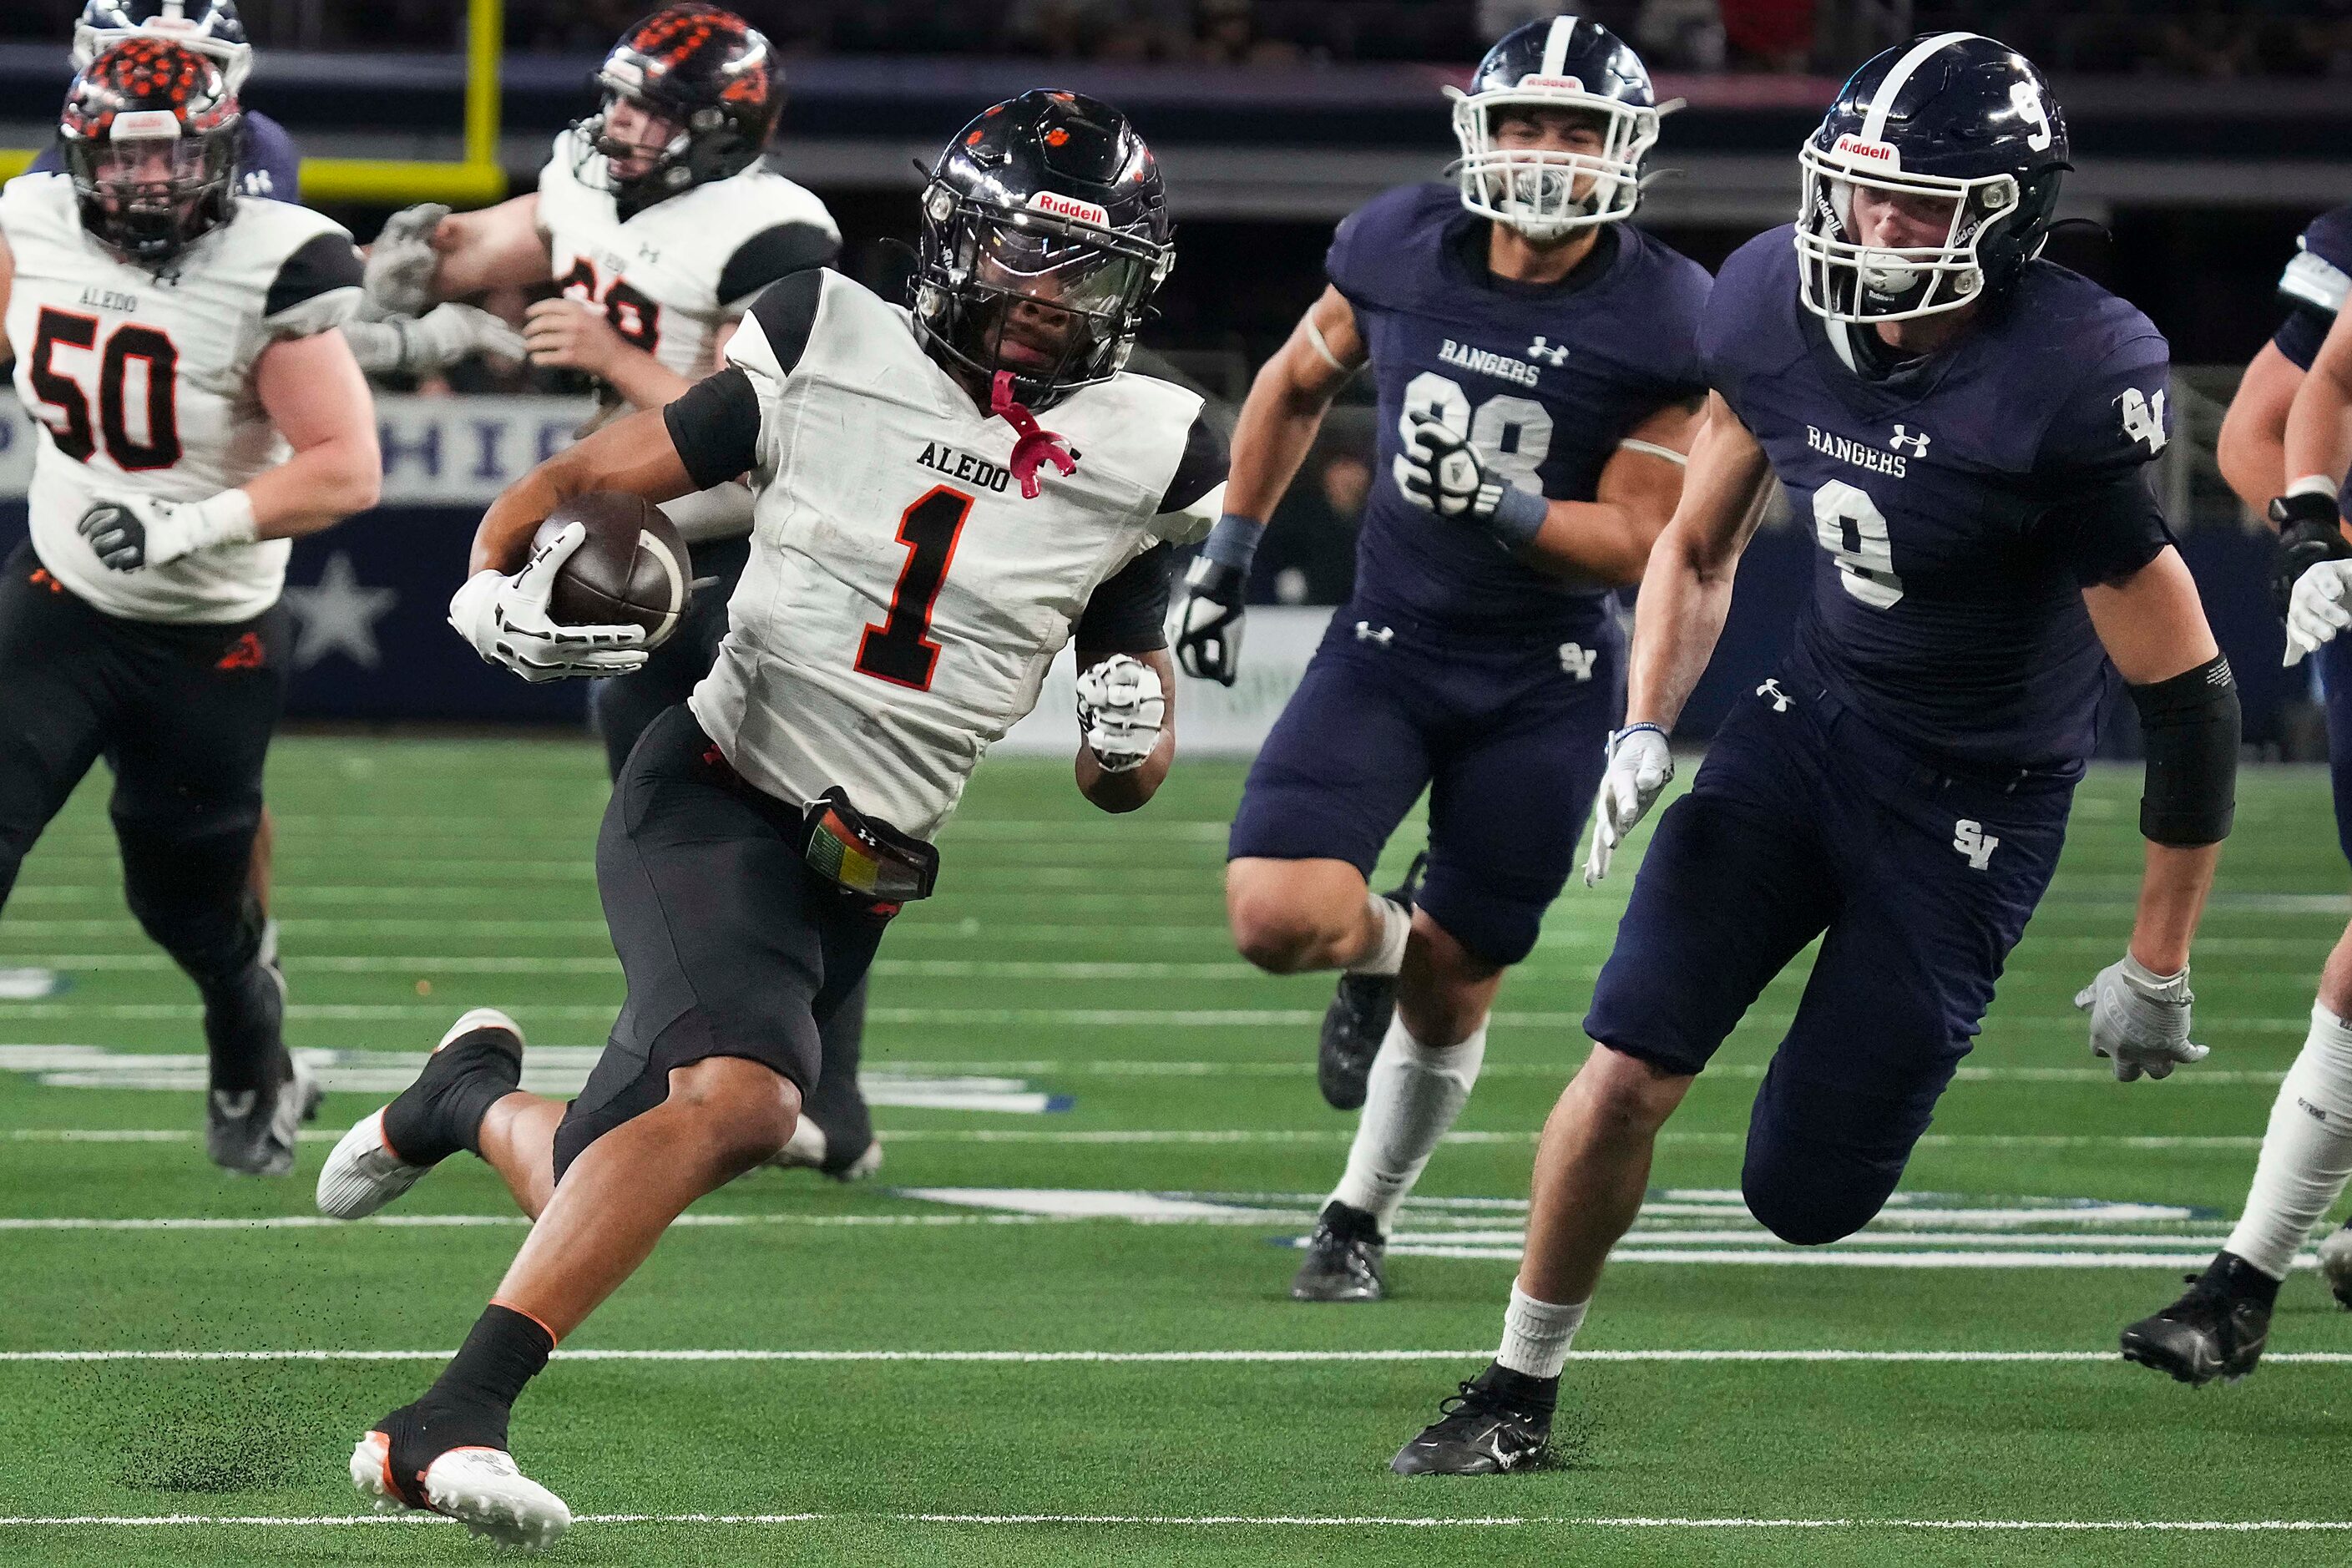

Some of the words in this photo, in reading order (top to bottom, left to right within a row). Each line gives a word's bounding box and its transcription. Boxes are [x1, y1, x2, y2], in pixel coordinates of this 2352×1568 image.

[1839, 137, 1891, 160] Riddell
[1039, 195, 1102, 223] Riddell
[79, 287, 138, 313] ALEDO
[1437, 337, 1541, 387] RANGERS
[29, 303, 185, 473] 50
[916, 441, 1011, 493] ALEDO
[1806, 424, 1907, 479] RANGERS
[852, 483, 976, 692] 1
[1559, 641, 1598, 682] SV
[1953, 818, 2000, 871] SV
